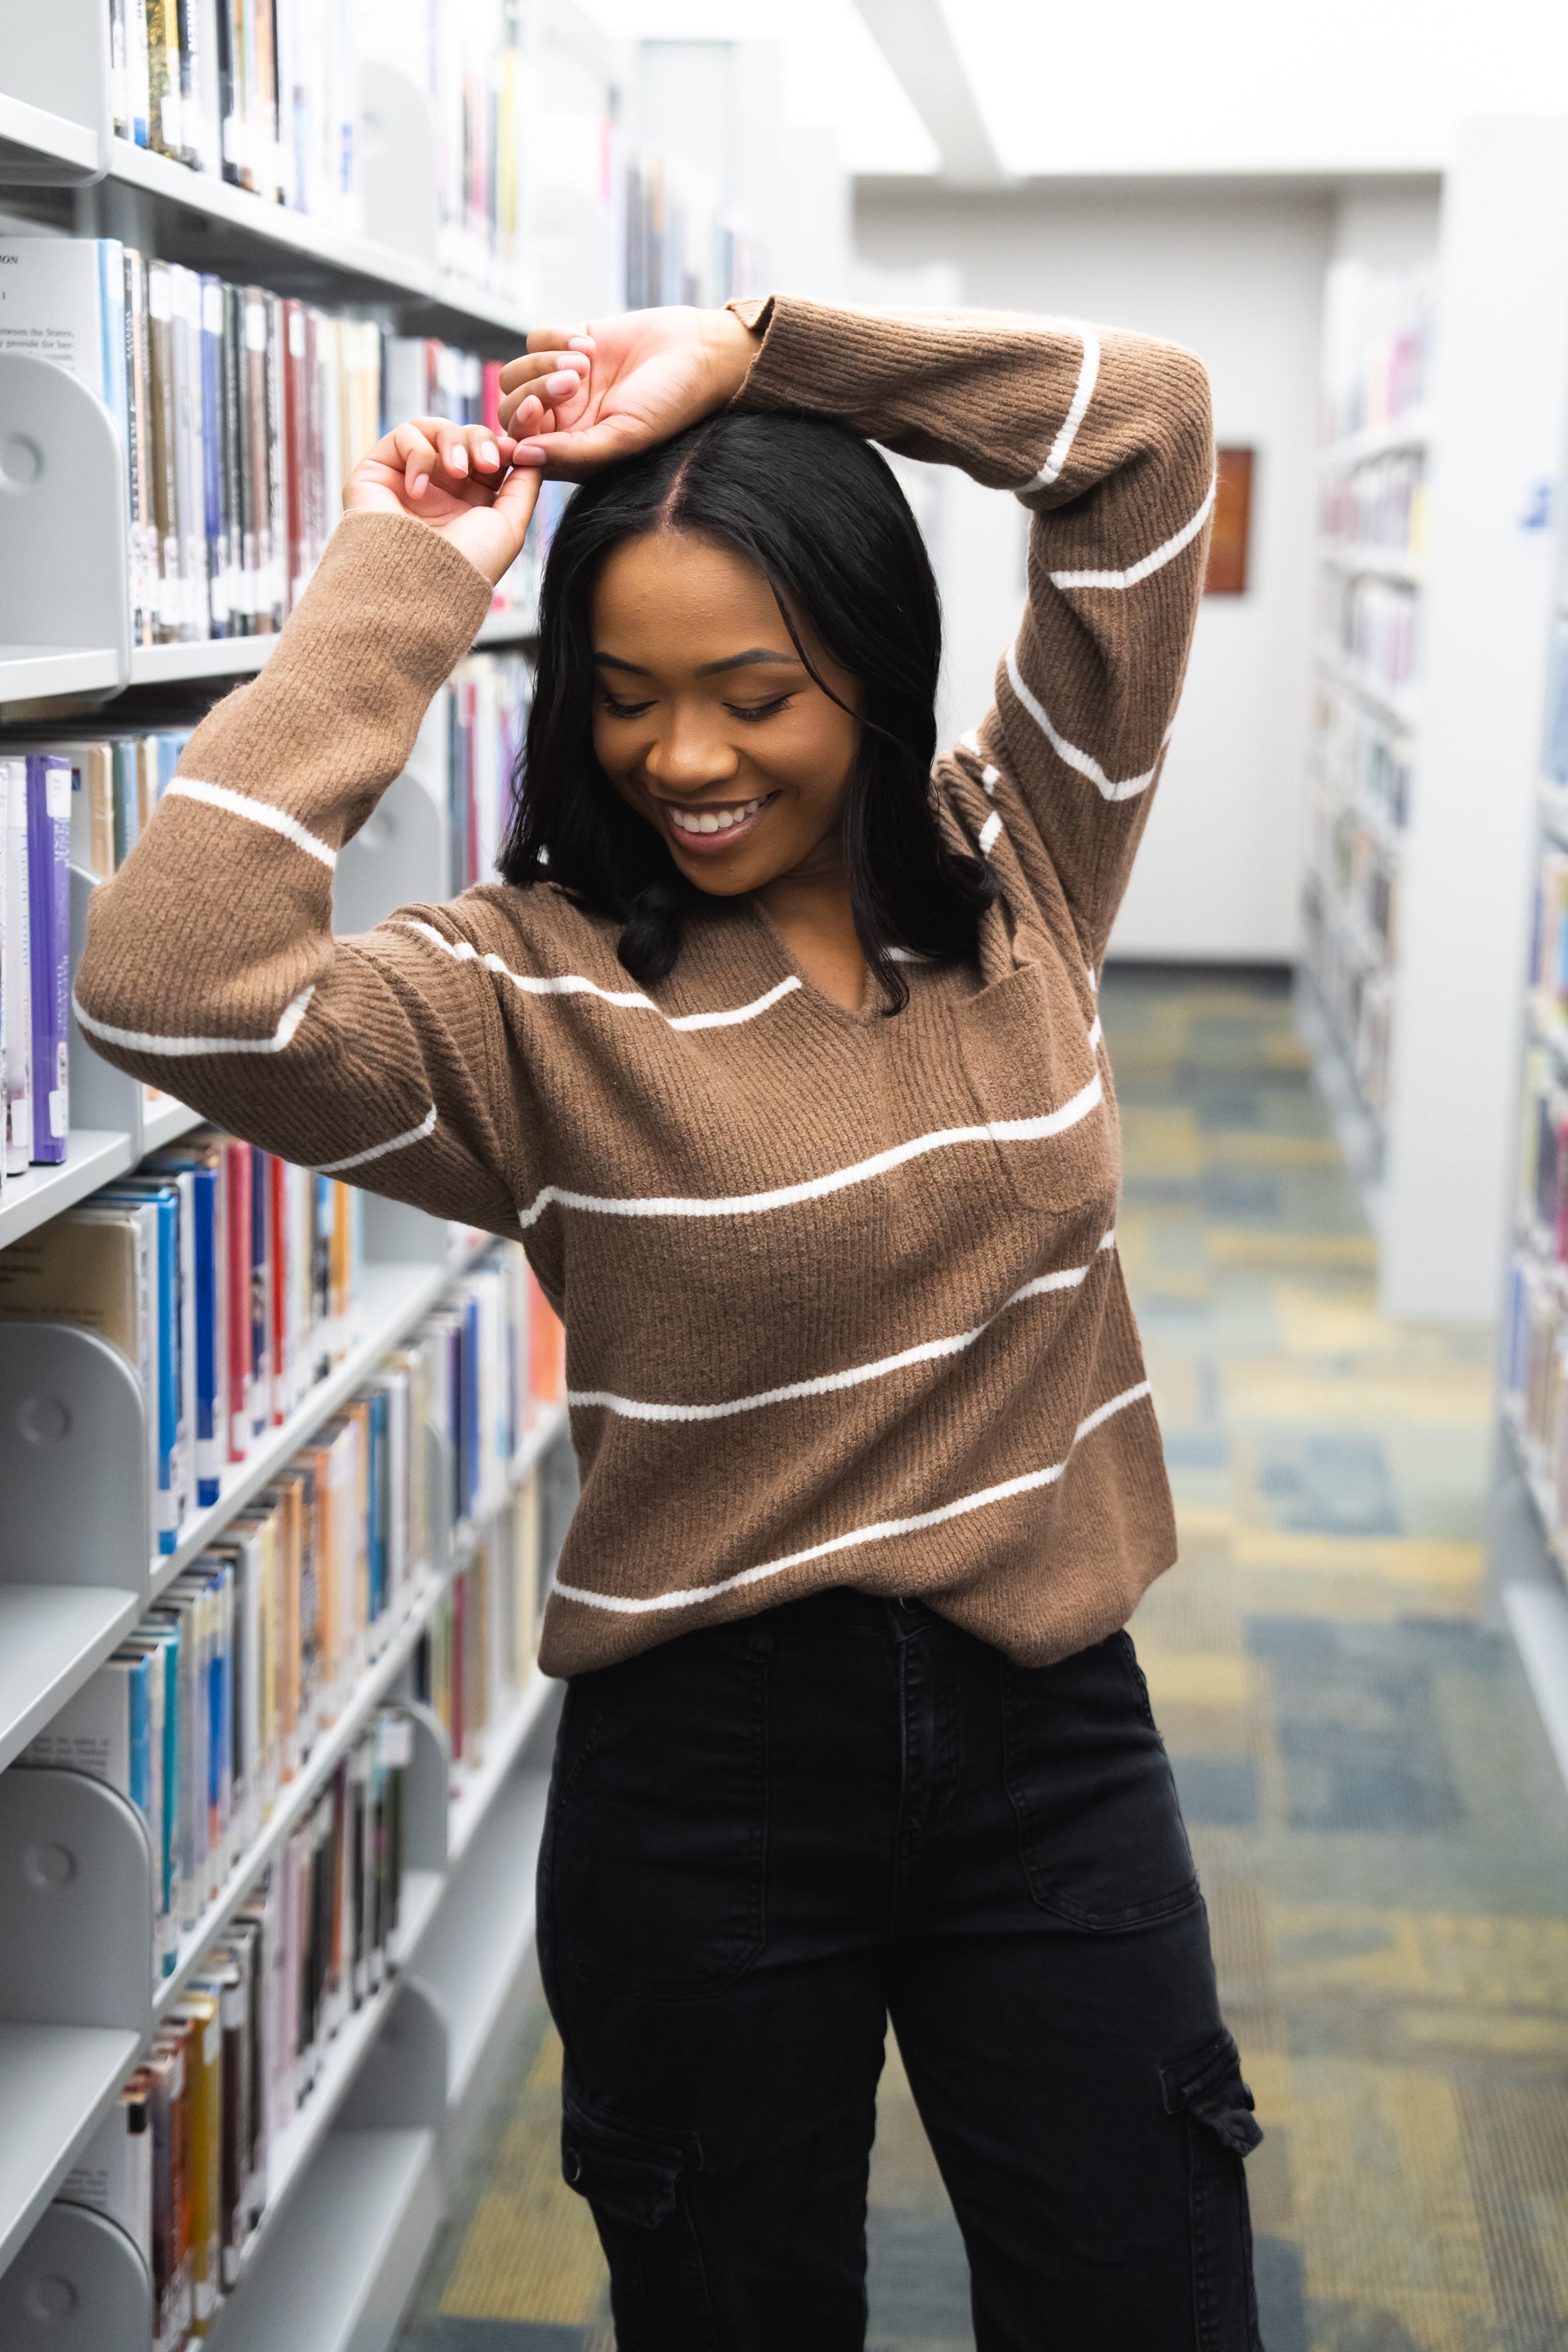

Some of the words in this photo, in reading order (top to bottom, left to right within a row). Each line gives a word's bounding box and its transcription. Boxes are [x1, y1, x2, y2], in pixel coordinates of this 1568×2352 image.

[30, 328, 43, 337] the
[6, 339, 38, 350] provide
[42, 339, 54, 349] for
